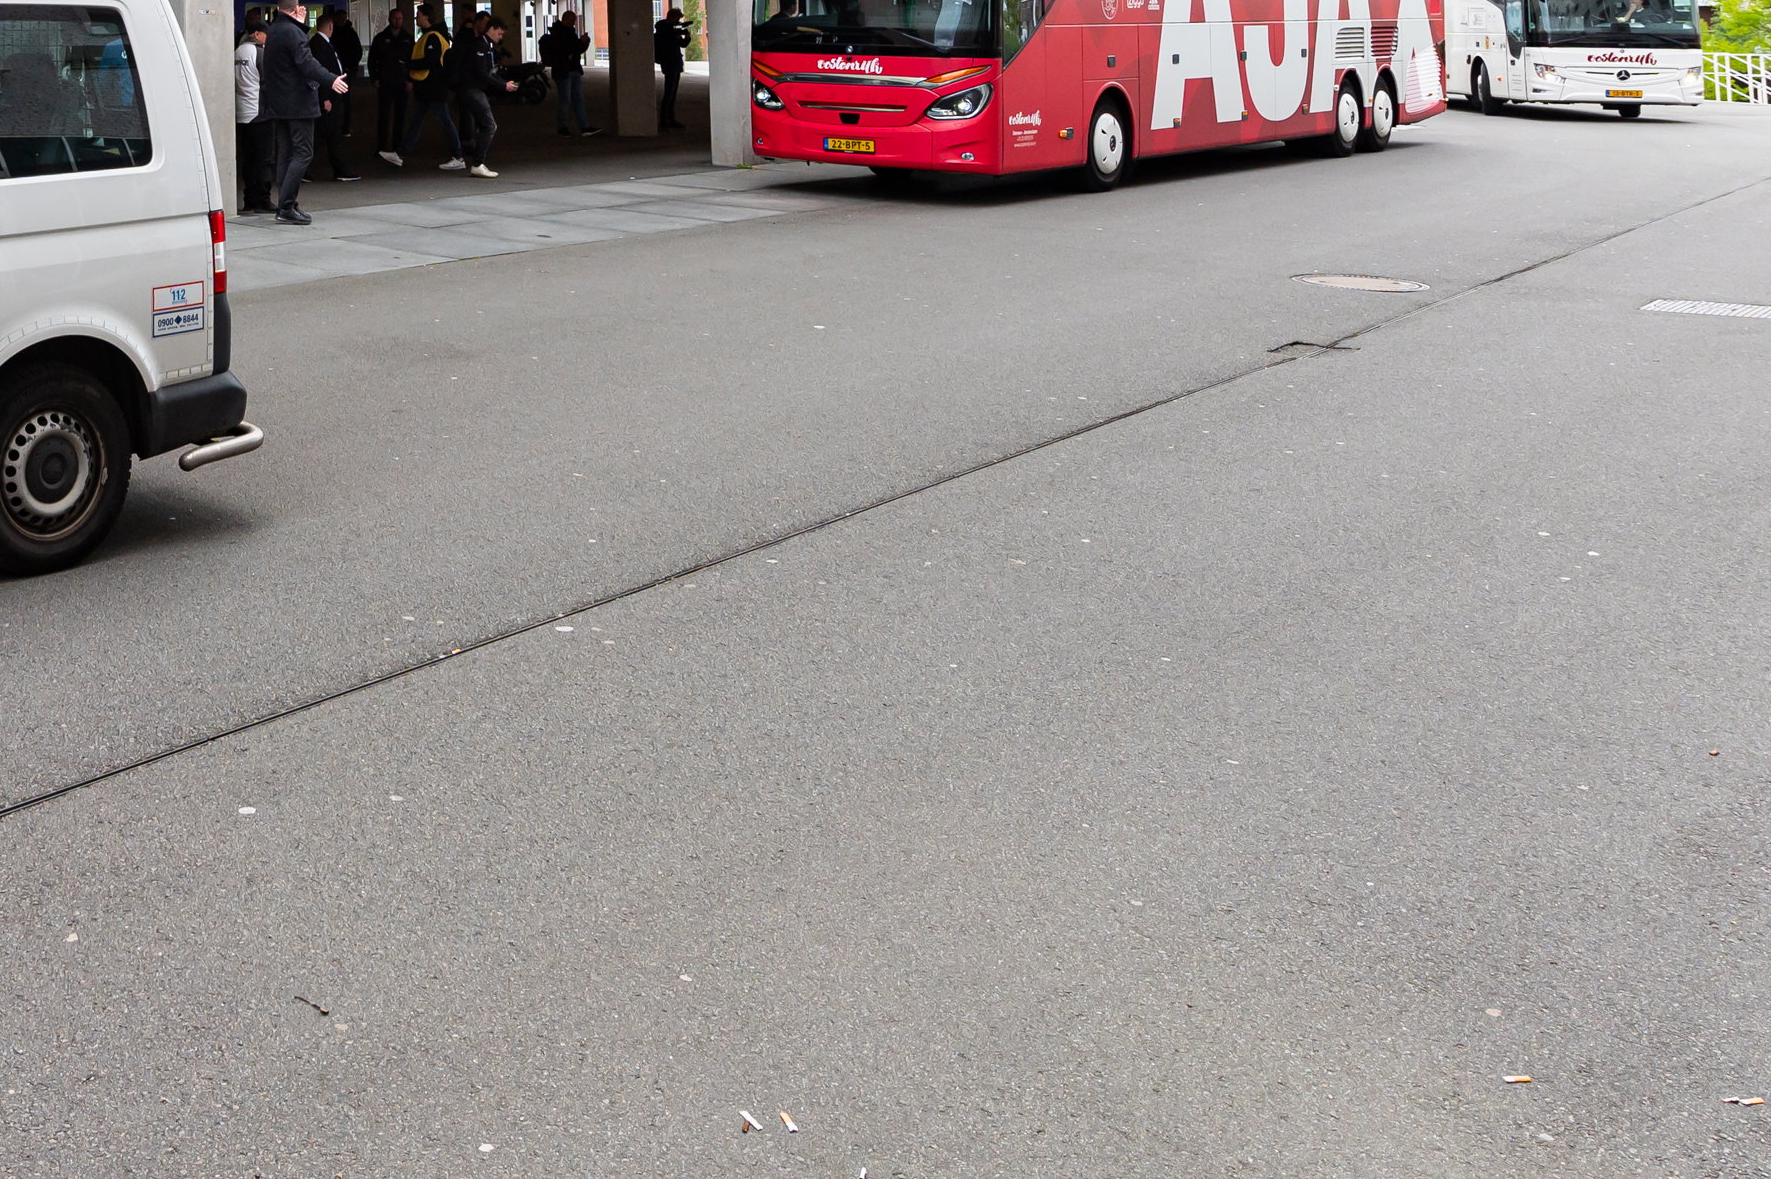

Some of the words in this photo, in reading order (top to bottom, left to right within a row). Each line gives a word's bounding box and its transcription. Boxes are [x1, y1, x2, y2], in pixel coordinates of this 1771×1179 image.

[831, 140, 871, 151] 22-BPT-5
[171, 288, 186, 301] 112
[157, 317, 174, 328] 0900
[182, 313, 198, 323] 8844
